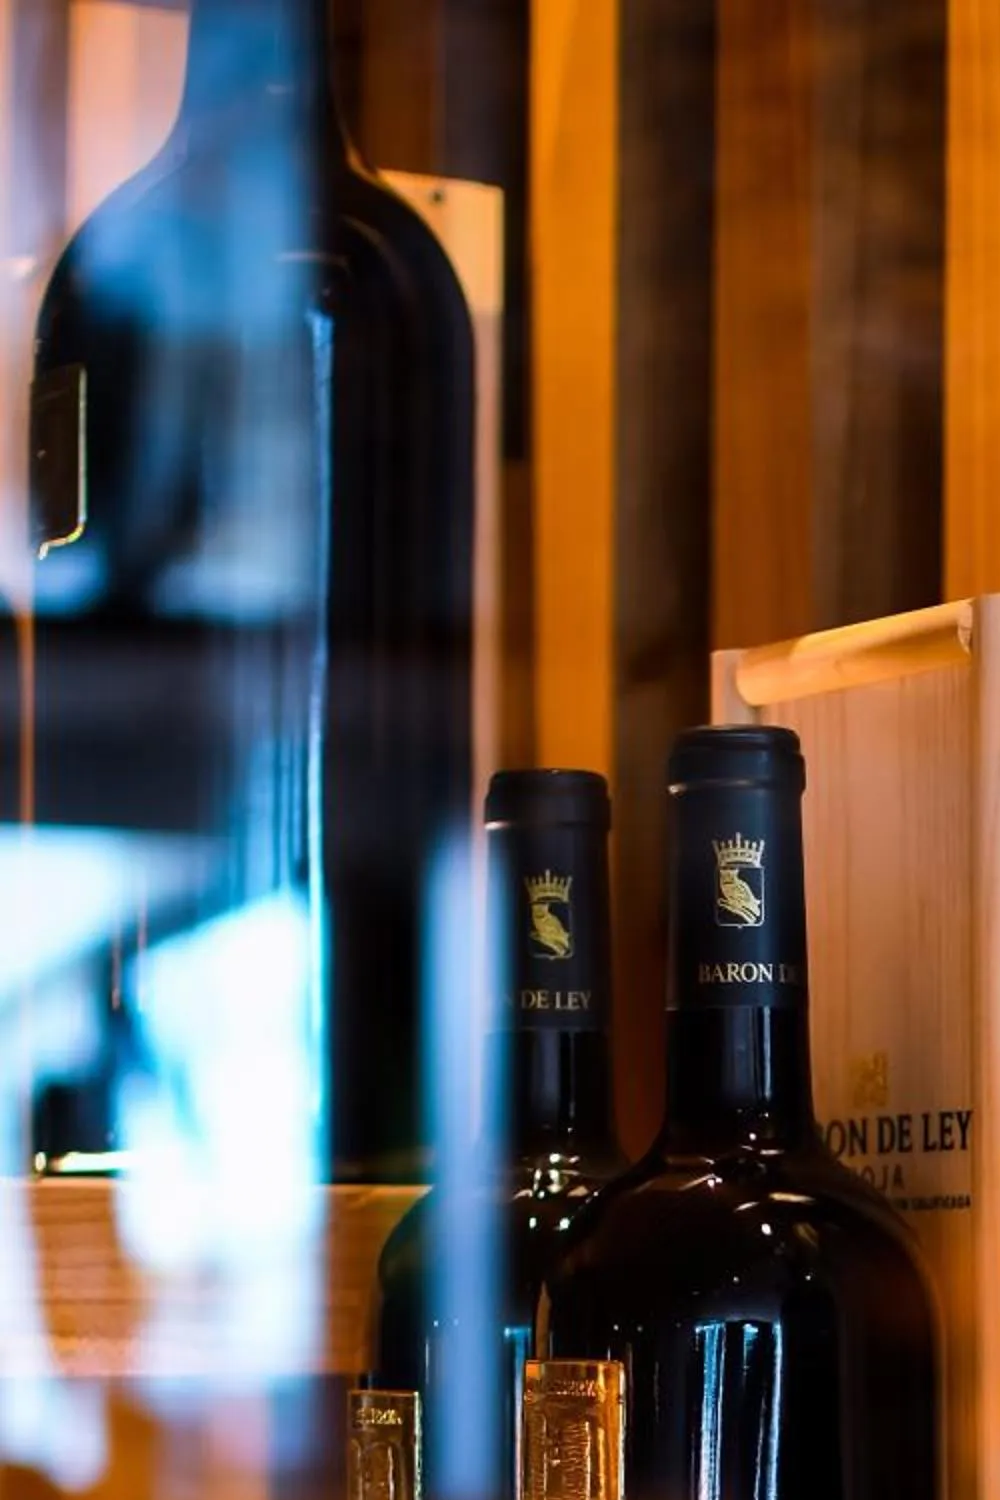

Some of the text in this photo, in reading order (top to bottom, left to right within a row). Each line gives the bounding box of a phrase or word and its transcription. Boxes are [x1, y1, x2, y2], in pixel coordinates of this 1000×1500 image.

[698, 962, 773, 984] BARON
[520, 989, 550, 1010] DE
[554, 989, 592, 1011] LEY
[876, 1113, 914, 1154] DE
[921, 1110, 974, 1153] LEY
